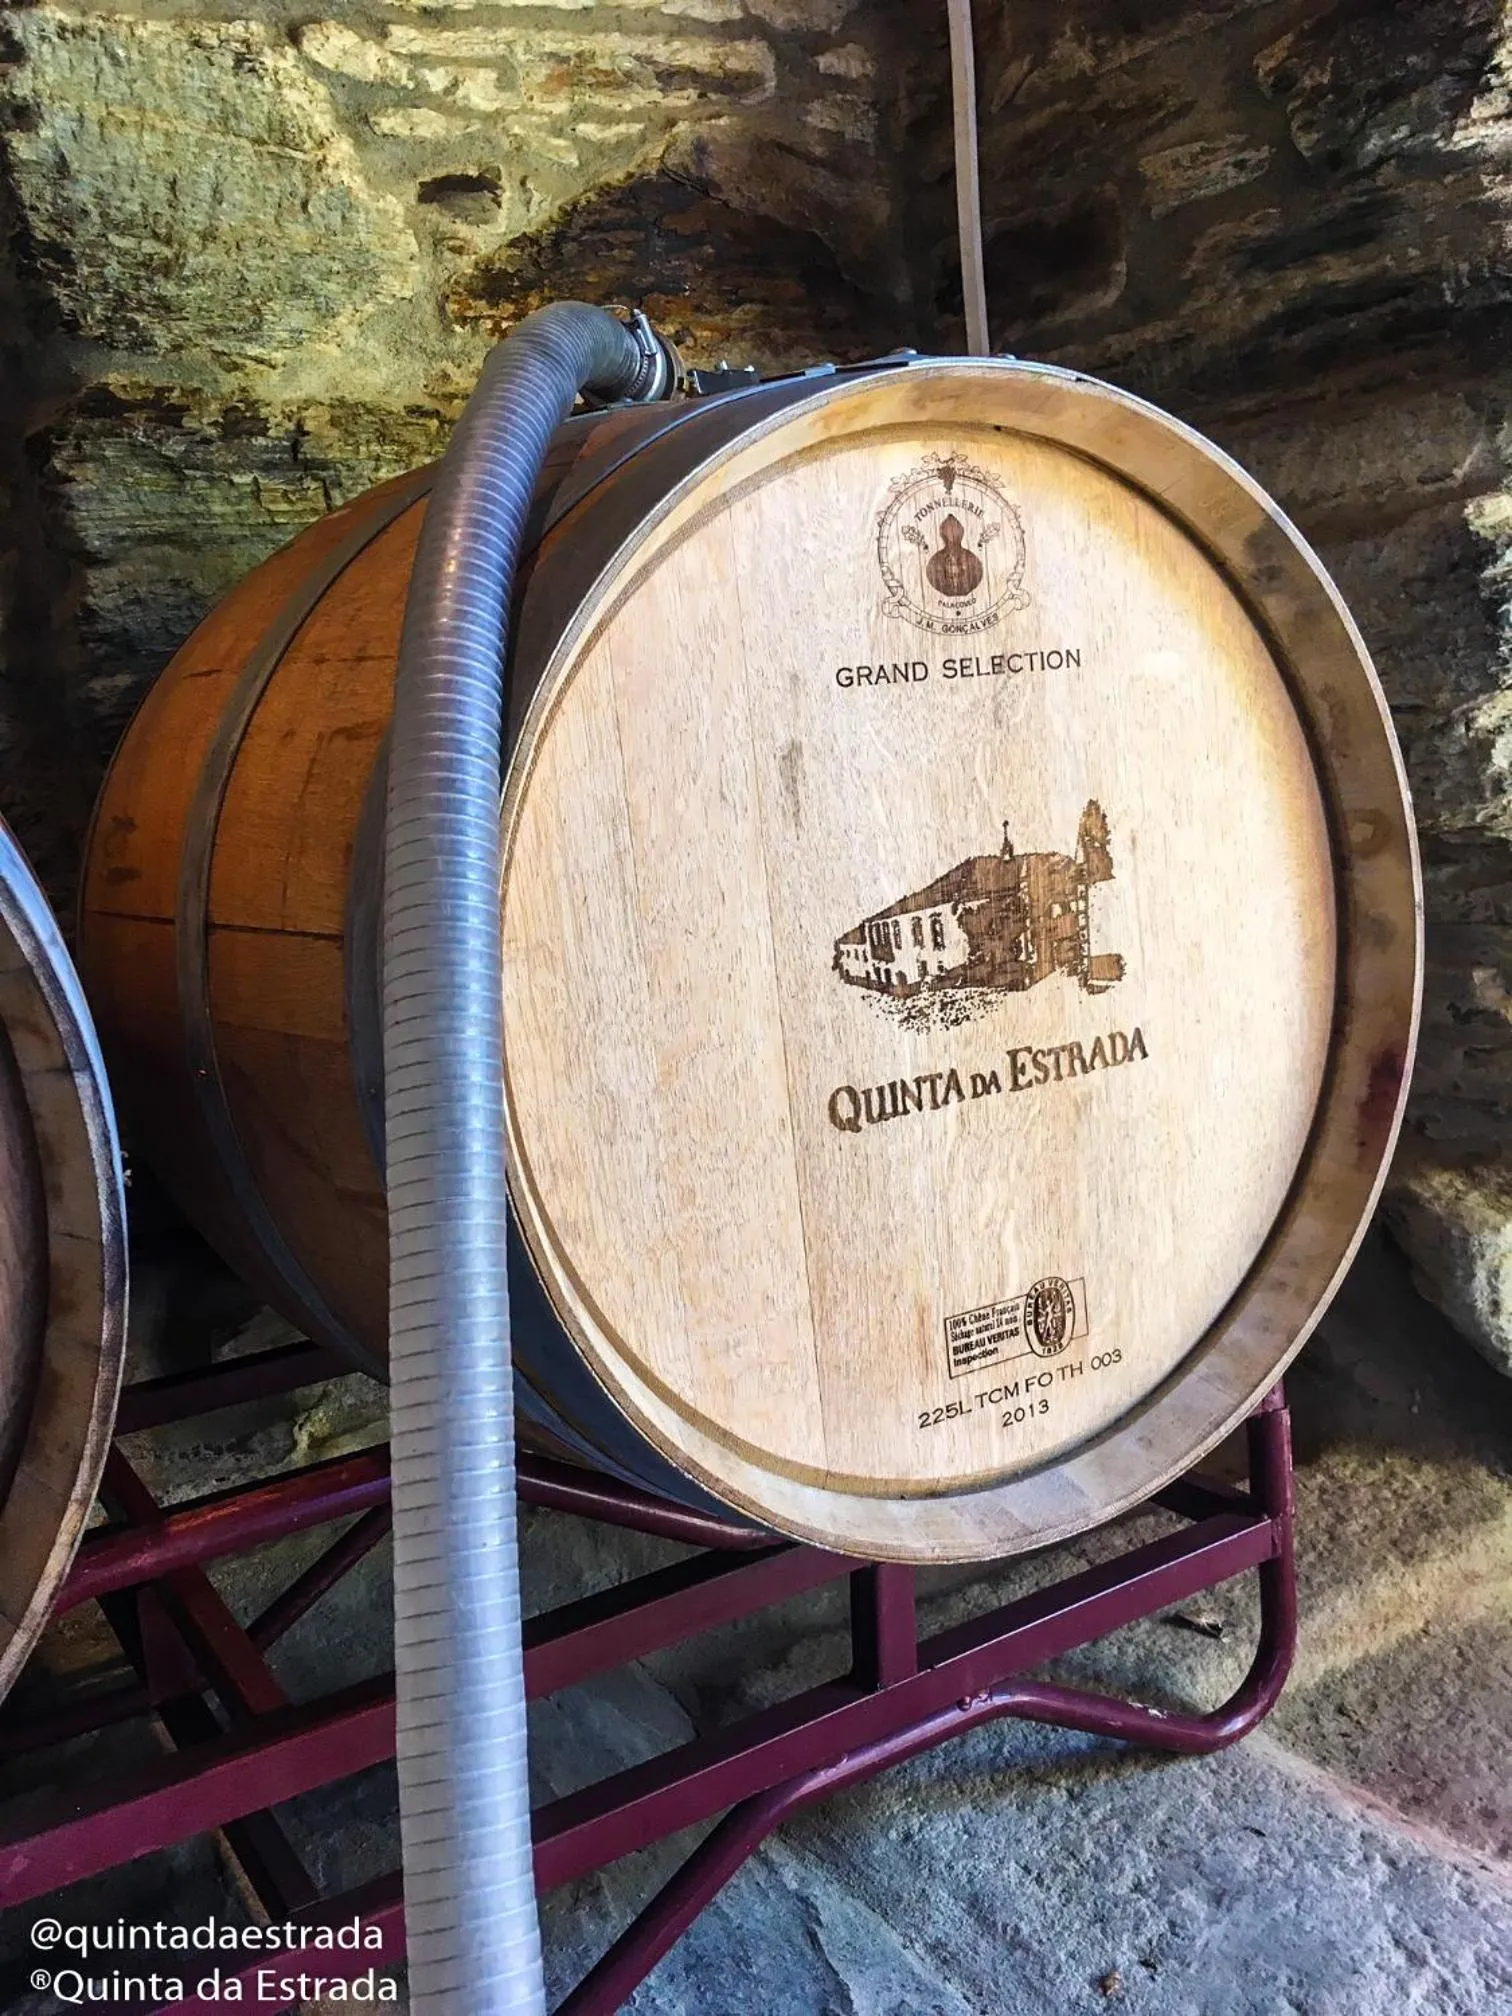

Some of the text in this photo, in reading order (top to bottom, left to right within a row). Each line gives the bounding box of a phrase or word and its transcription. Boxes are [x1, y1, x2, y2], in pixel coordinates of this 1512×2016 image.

[914, 496, 985, 522] TONNELLERIE
[941, 613, 999, 635] GONÇALVES
[835, 649, 1081, 688] GRAND SELECTION
[828, 1026, 1149, 1133] QUINTA DA ESTRADA
[949, 1317, 967, 1331] 100%
[953, 1327, 1020, 1356] BUREAU VERITAS
[953, 1347, 999, 1367] Inspection
[918, 1401, 972, 1429] 225L
[975, 1382, 1020, 1408] TCM
[1090, 1348, 1123, 1370] 003
[1002, 1399, 1050, 1427] 2013
